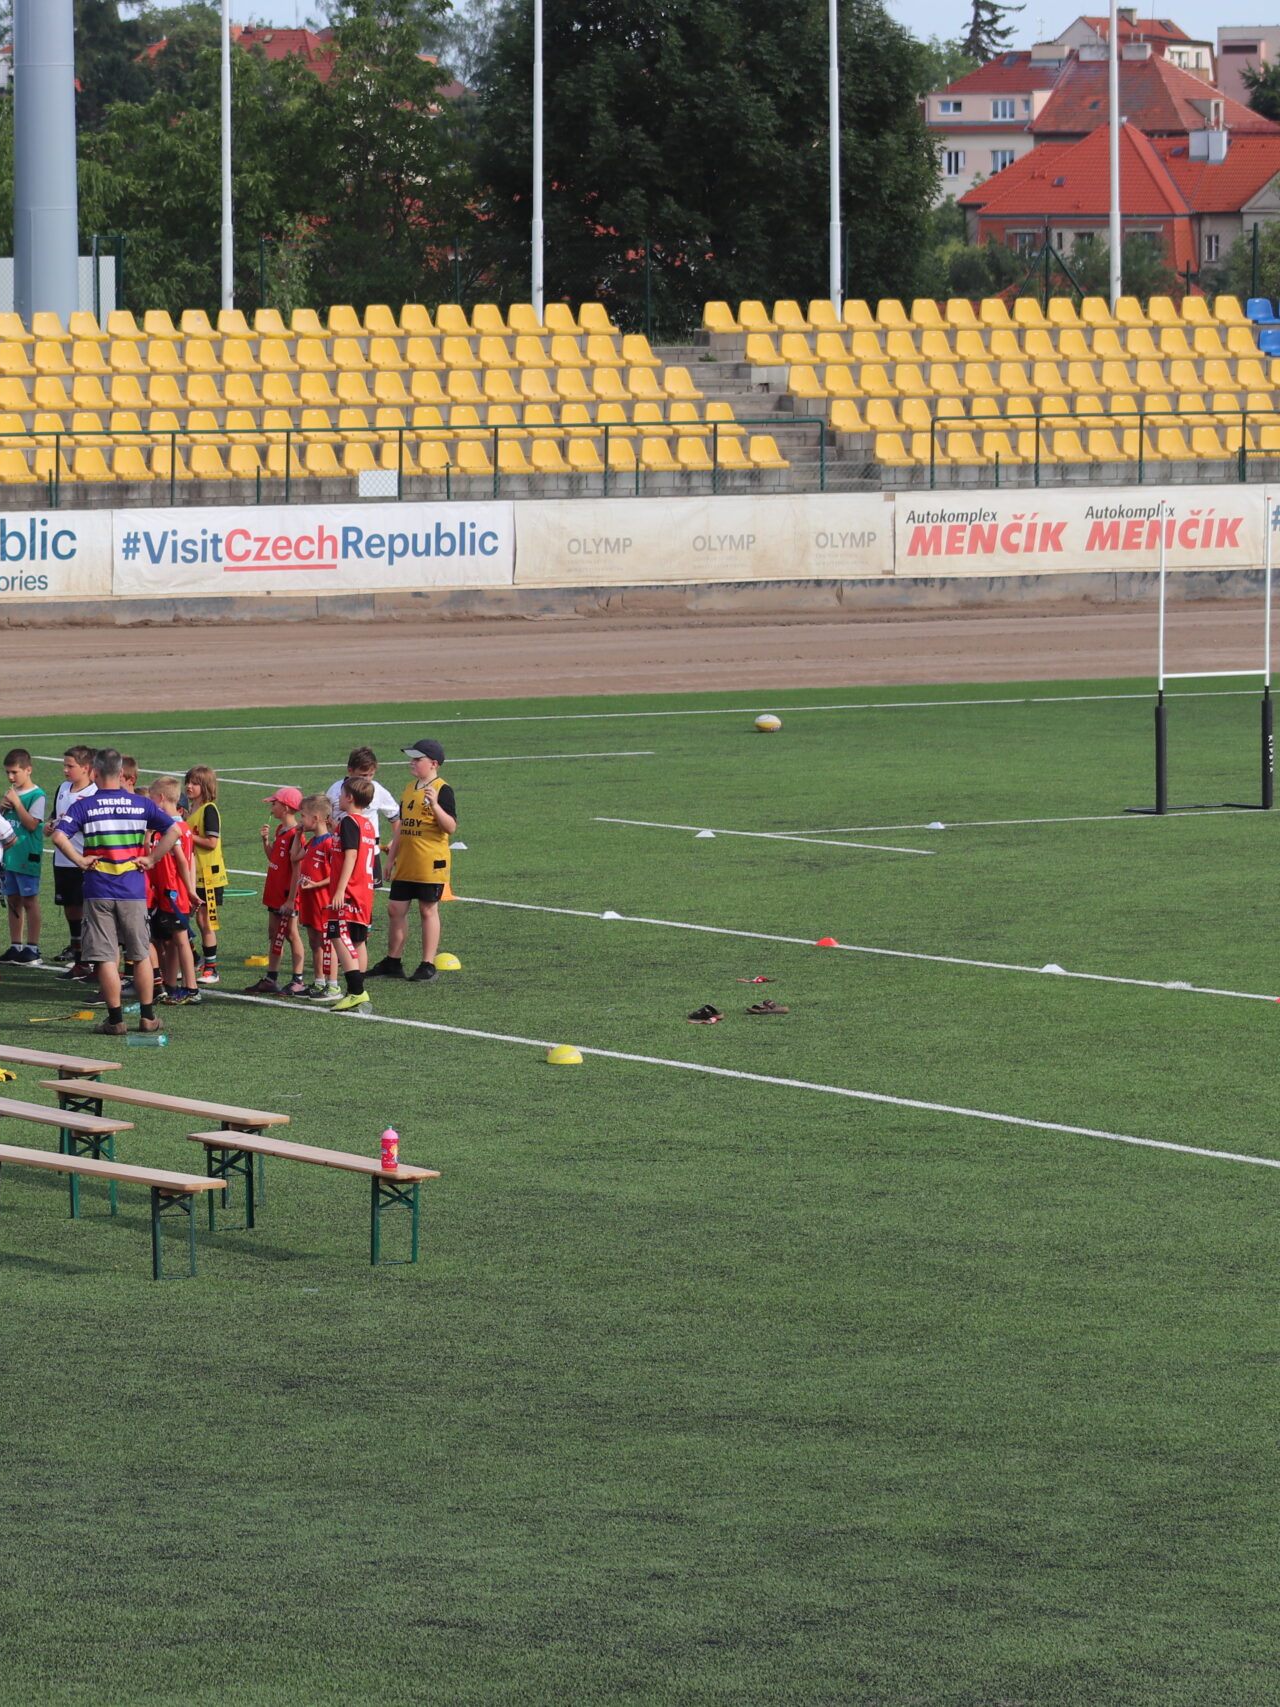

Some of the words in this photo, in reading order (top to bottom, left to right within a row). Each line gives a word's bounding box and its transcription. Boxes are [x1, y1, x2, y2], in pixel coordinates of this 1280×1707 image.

[906, 508, 998, 525] Autokomplex
[1085, 504, 1175, 521] Autokomplx
[907, 512, 1068, 556] MENČÍK
[1085, 508, 1244, 551] MENČÍK
[567, 537, 632, 555] OLYMP
[692, 534, 756, 551] OLYMP
[815, 532, 877, 549] OLYMP
[87, 807, 115, 816] RAGBY
[116, 807, 145, 815] OLYMP
[401, 818, 423, 827] GBY
